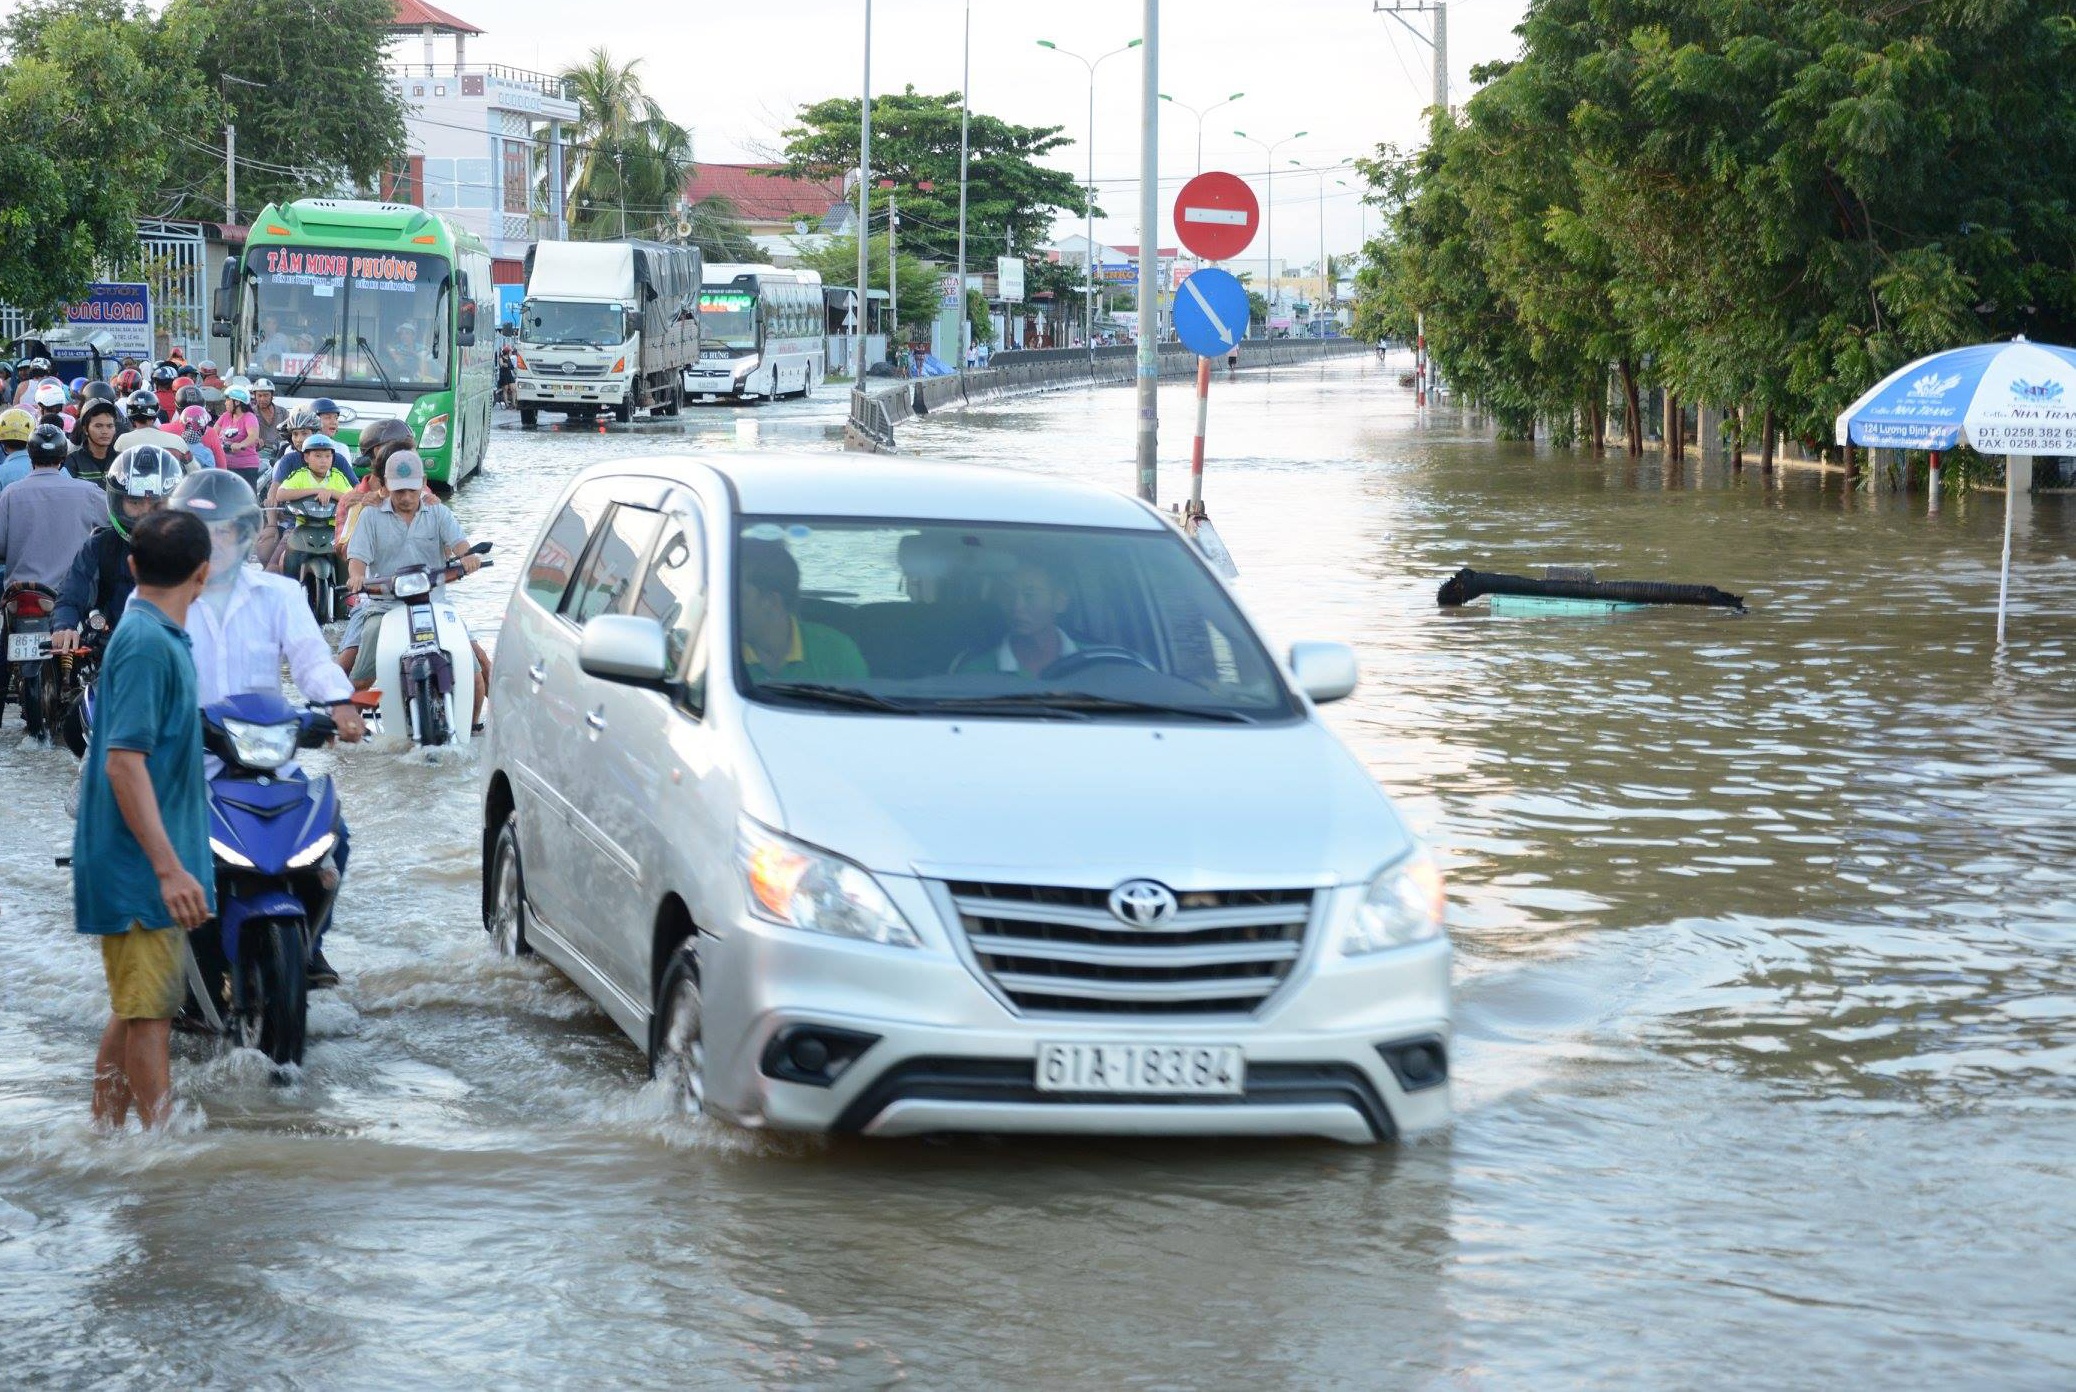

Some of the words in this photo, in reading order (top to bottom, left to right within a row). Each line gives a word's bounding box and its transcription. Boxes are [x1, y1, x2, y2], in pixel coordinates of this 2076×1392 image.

[267, 247, 303, 273] TÂM
[305, 253, 347, 277] MINH
[352, 255, 417, 281] PHƯƠNG
[103, 301, 144, 320] LOAN
[2011, 409, 2039, 419] NHA
[1864, 422, 1878, 433] 124
[1909, 424, 1928, 437] Định
[1979, 428, 1999, 438] ĐT:
[2004, 428, 2061, 438] 0258.382
[1978, 439, 2005, 449] FAX:
[2009, 439, 2062, 449] 0258.356
